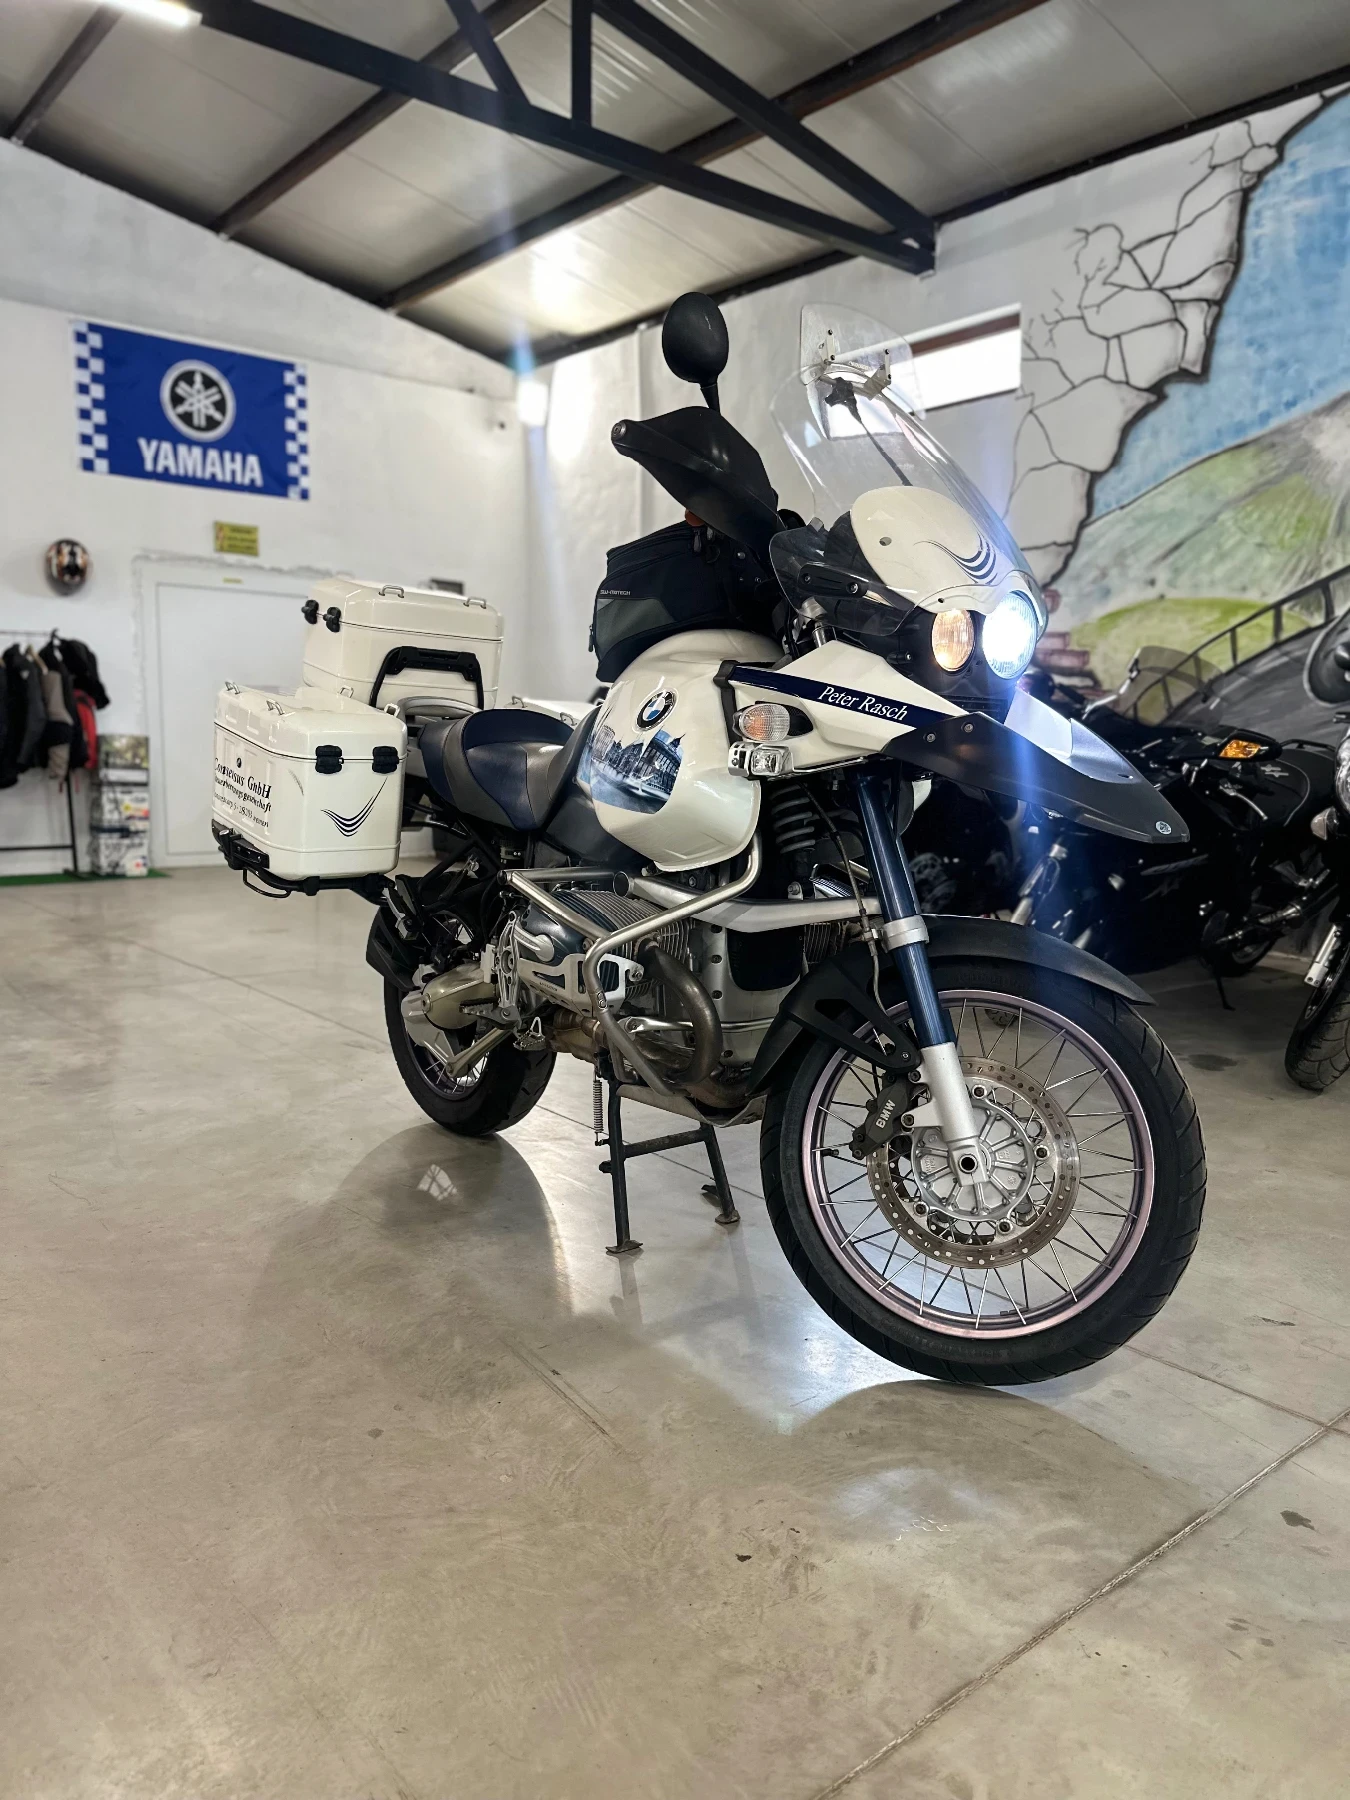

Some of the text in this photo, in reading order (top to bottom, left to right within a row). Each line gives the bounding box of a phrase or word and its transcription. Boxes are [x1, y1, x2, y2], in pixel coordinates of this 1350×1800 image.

[137, 436, 264, 488] YAMAHA
[817, 685, 909, 721] Peter Rasch
[247, 775, 272, 800] GmbH
[875, 1099, 896, 1129] BMW
